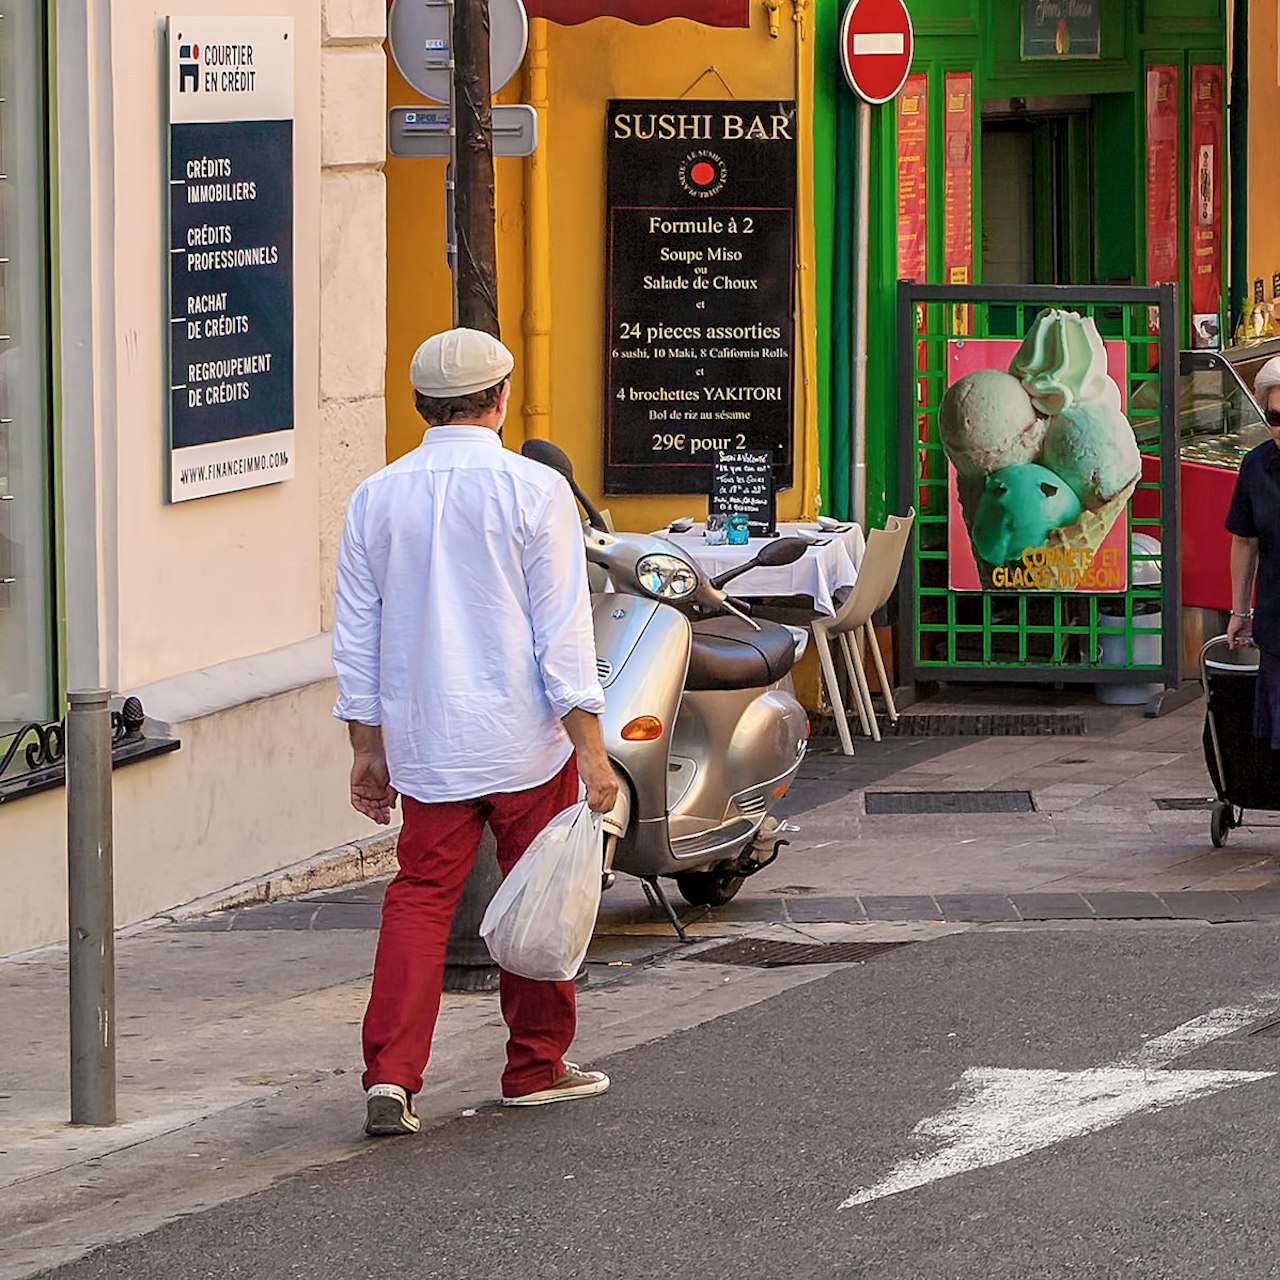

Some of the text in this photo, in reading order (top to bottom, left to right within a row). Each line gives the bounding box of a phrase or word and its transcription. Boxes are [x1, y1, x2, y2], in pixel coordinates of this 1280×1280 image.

[204, 43, 254, 66] COURTIER
[204, 67, 256, 93] EN CRÉDIT
[613, 113, 793, 140] SUSHI BAR
[186, 155, 232, 179] CRÉDITS
[187, 181, 257, 204] IMMOBILIERS
[187, 223, 233, 247] CRÉDITS
[648, 216, 754, 234] Formule à 2
[187, 245, 279, 273] PROFESSIONNELS
[660, 246, 743, 264] Soupe Miso
[693, 267, 708, 275] ou
[643, 276, 758, 290] Salade de Choux
[187, 292, 228, 315] RACHAT
[695, 300, 706, 310] et
[188, 314, 249, 340] DE CRÉDITS
[619, 321, 781, 344] 24 pieces assorties
[612, 348, 619, 359] 6
[653, 348, 666, 359] 10
[668, 348, 698, 360] Maki,
[700, 348, 707, 359] 8
[708, 347, 760, 359] California
[761, 348, 789, 359] Rolls
[188, 353, 272, 384] REGROUPEMENT
[695, 368, 705, 377] et
[188, 381, 250, 408] DE CRÉDITS
[616, 386, 782, 401] 4 brochettes YAKITORI
[648, 408, 751, 421] Bol de riz au sésame
[652, 433, 747, 455] 29€ pour 2
[180, 451, 287, 484] WWW.FINANCEIMMO.COM
[1022, 546, 1121, 570] CORNETS ET
[992, 566, 1122, 589] GLACES MAISON
